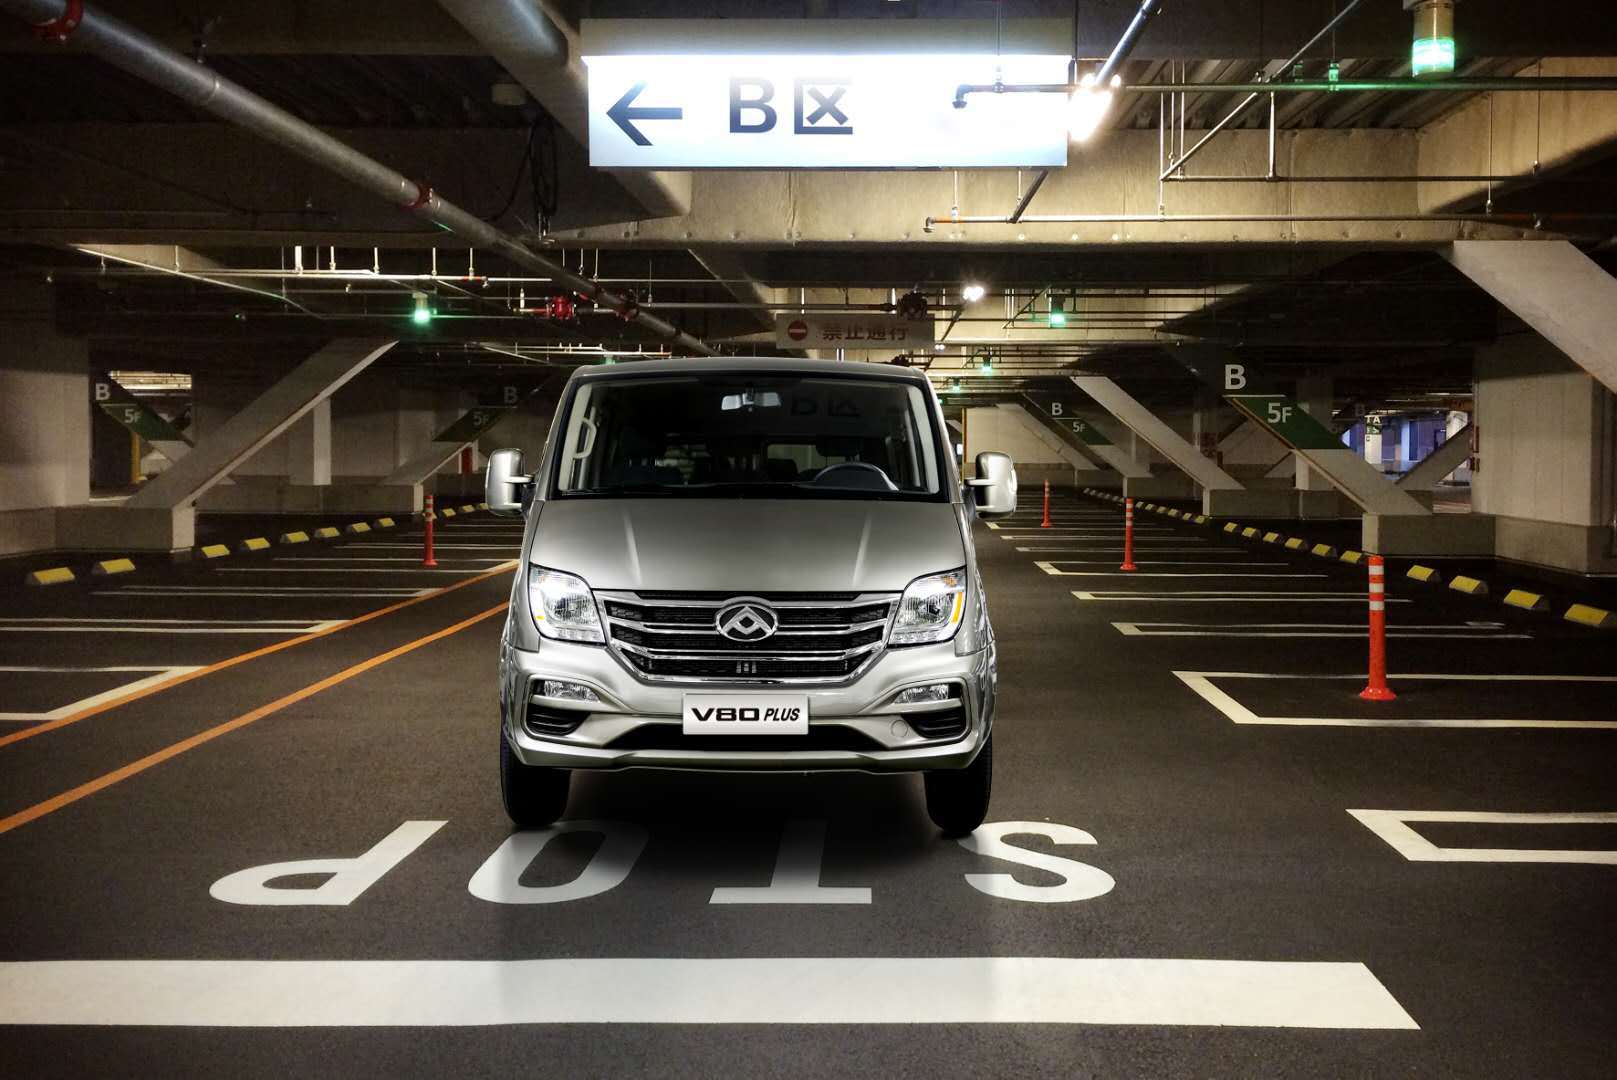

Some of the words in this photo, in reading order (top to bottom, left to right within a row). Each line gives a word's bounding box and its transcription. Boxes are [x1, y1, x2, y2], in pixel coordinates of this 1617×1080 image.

[1224, 364, 1247, 390] B
[95, 383, 110, 400] B
[503, 386, 518, 405] B
[124, 408, 141, 424] 5F
[1051, 402, 1063, 416] B
[1267, 402, 1292, 424] 5F
[1072, 421, 1086, 433] 5F
[691, 707, 760, 722] V80
[764, 707, 801, 722] PLUS
[208, 819, 1116, 905] STOP
